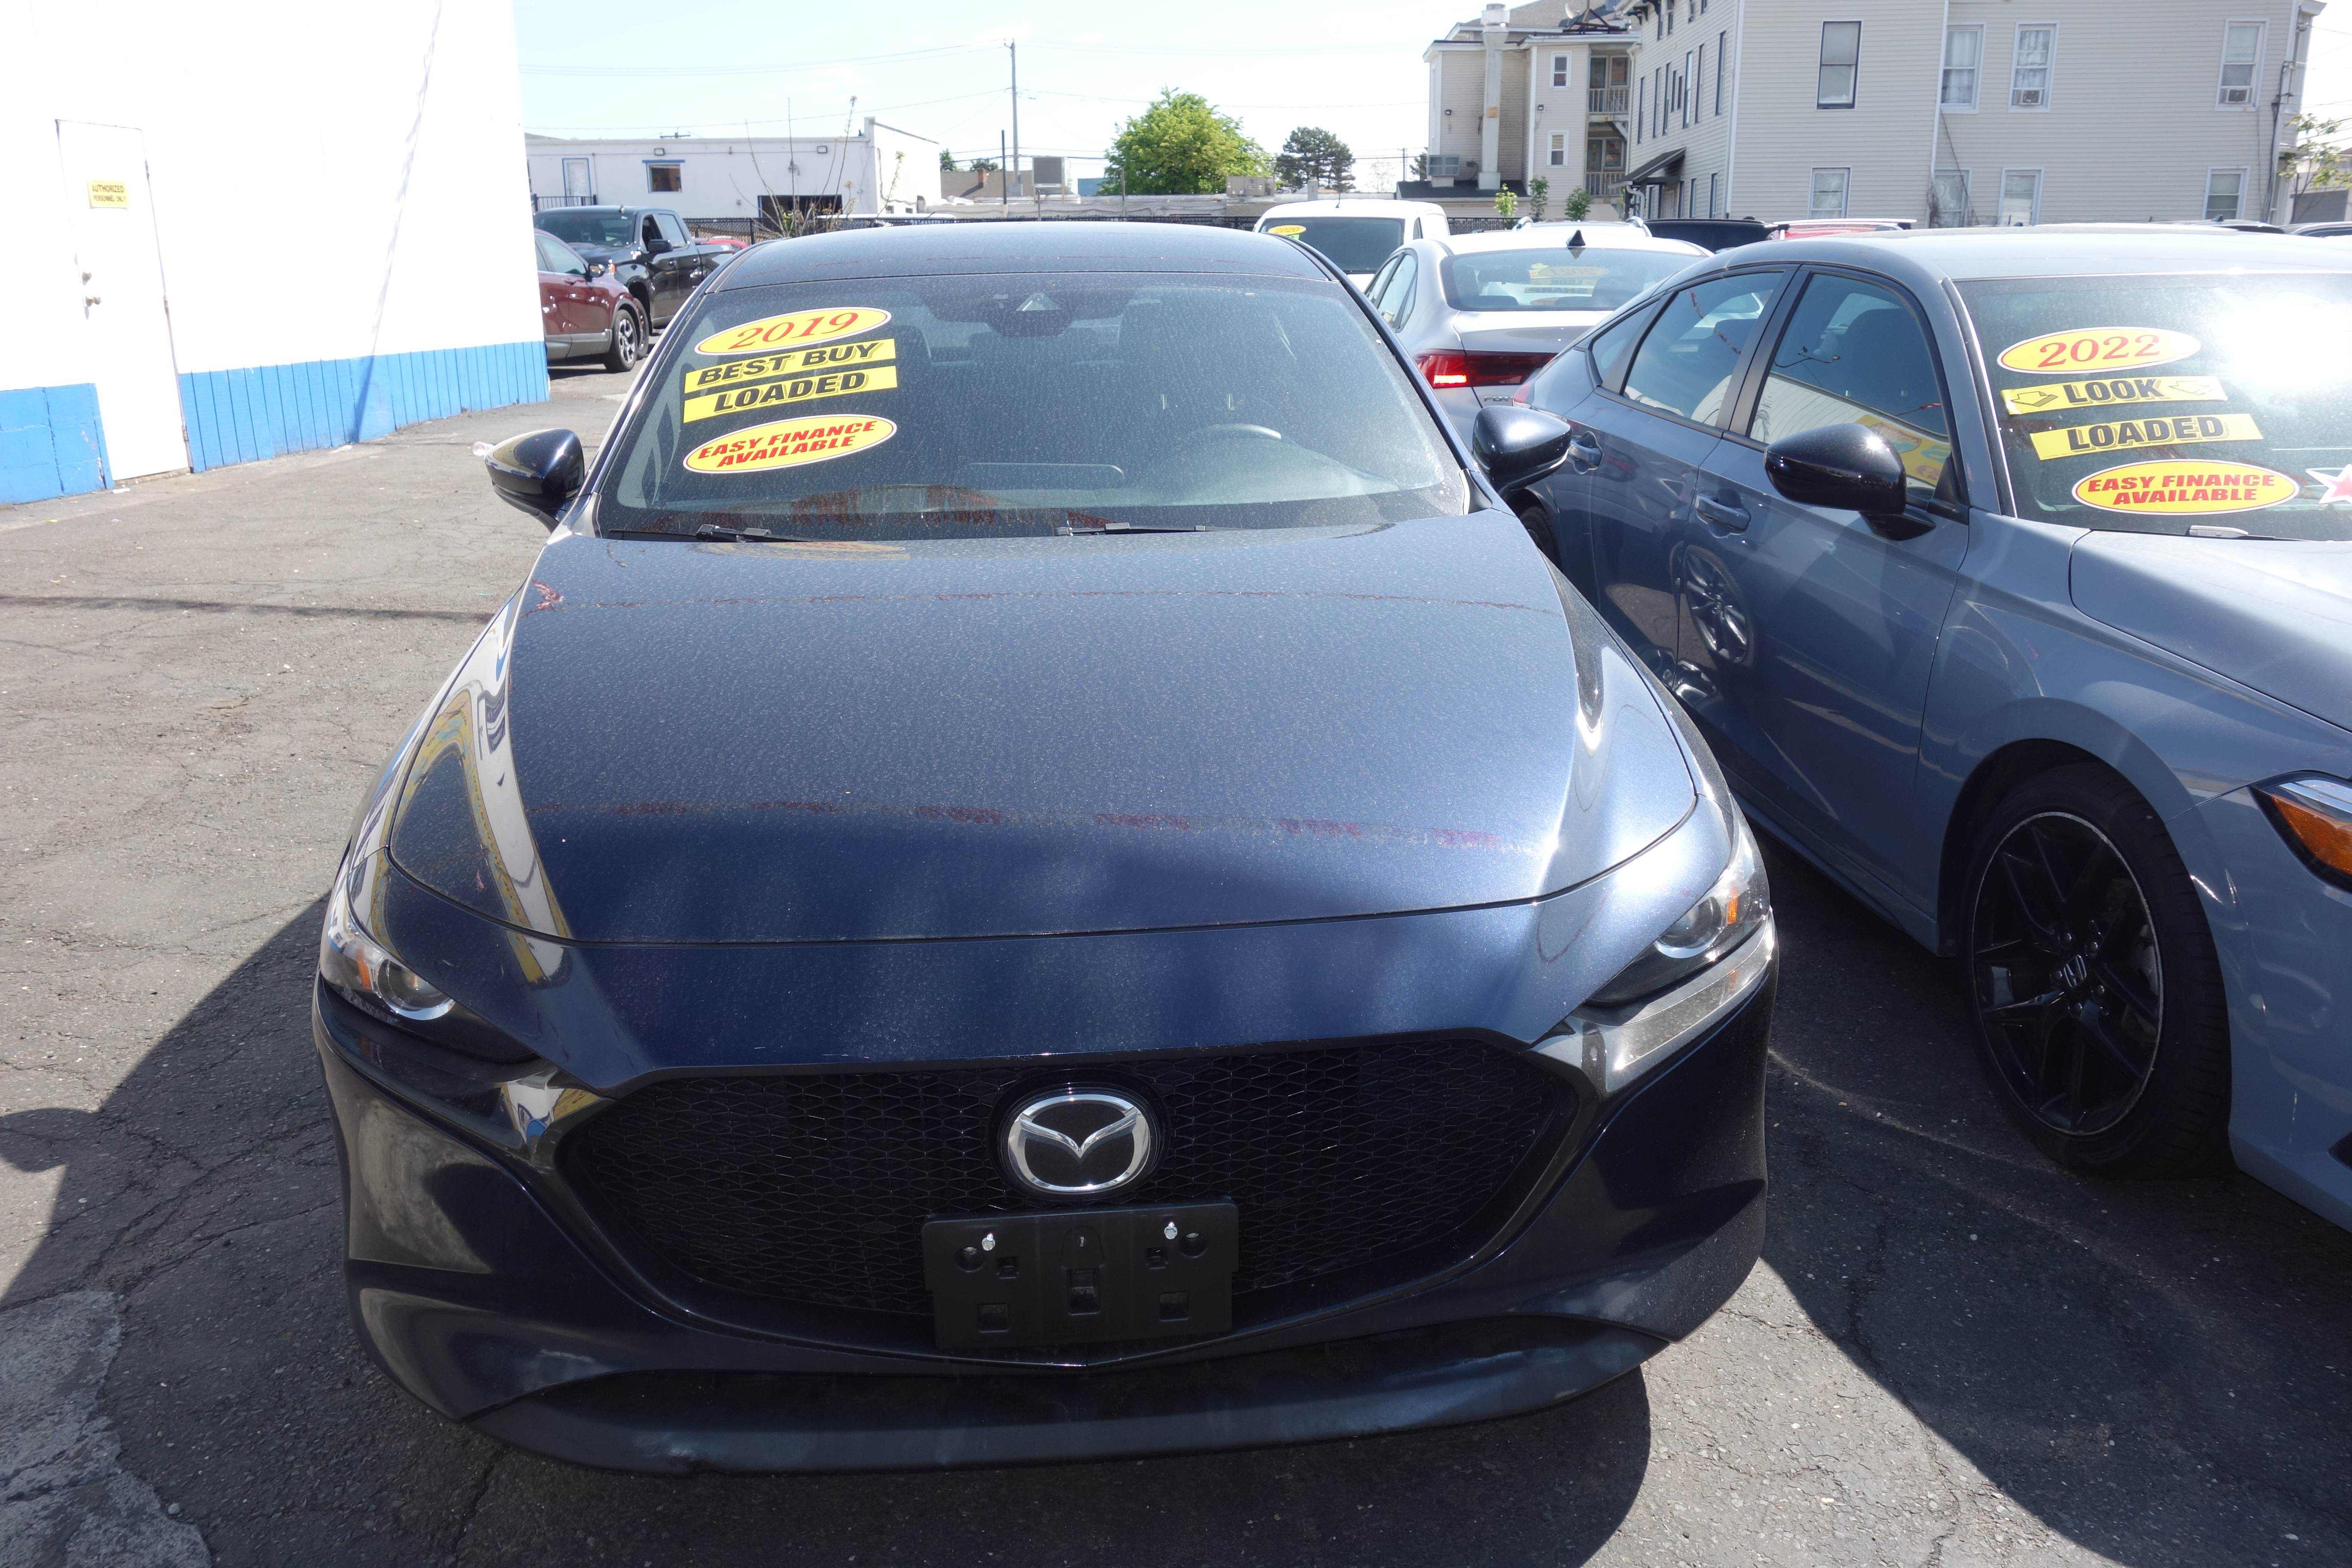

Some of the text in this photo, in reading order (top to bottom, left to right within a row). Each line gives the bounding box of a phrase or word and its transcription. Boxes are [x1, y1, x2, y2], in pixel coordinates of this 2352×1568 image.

[92, 184, 124, 193] AUTHORIZED
[727, 312, 858, 350] 2019
[697, 342, 884, 386] BEST BUY
[2038, 334, 2161, 368] 2022
[714, 372, 867, 413] LOADED
[2063, 379, 2167, 404] LOOK
[698, 420, 877, 459] EASY FINANCE
[2067, 416, 2227, 452] LOADED
[716, 436, 855, 468] AVAILABLE
[2088, 474, 2275, 492] EASY FINANCE
[2113, 488, 2257, 505] AVAILABLE
